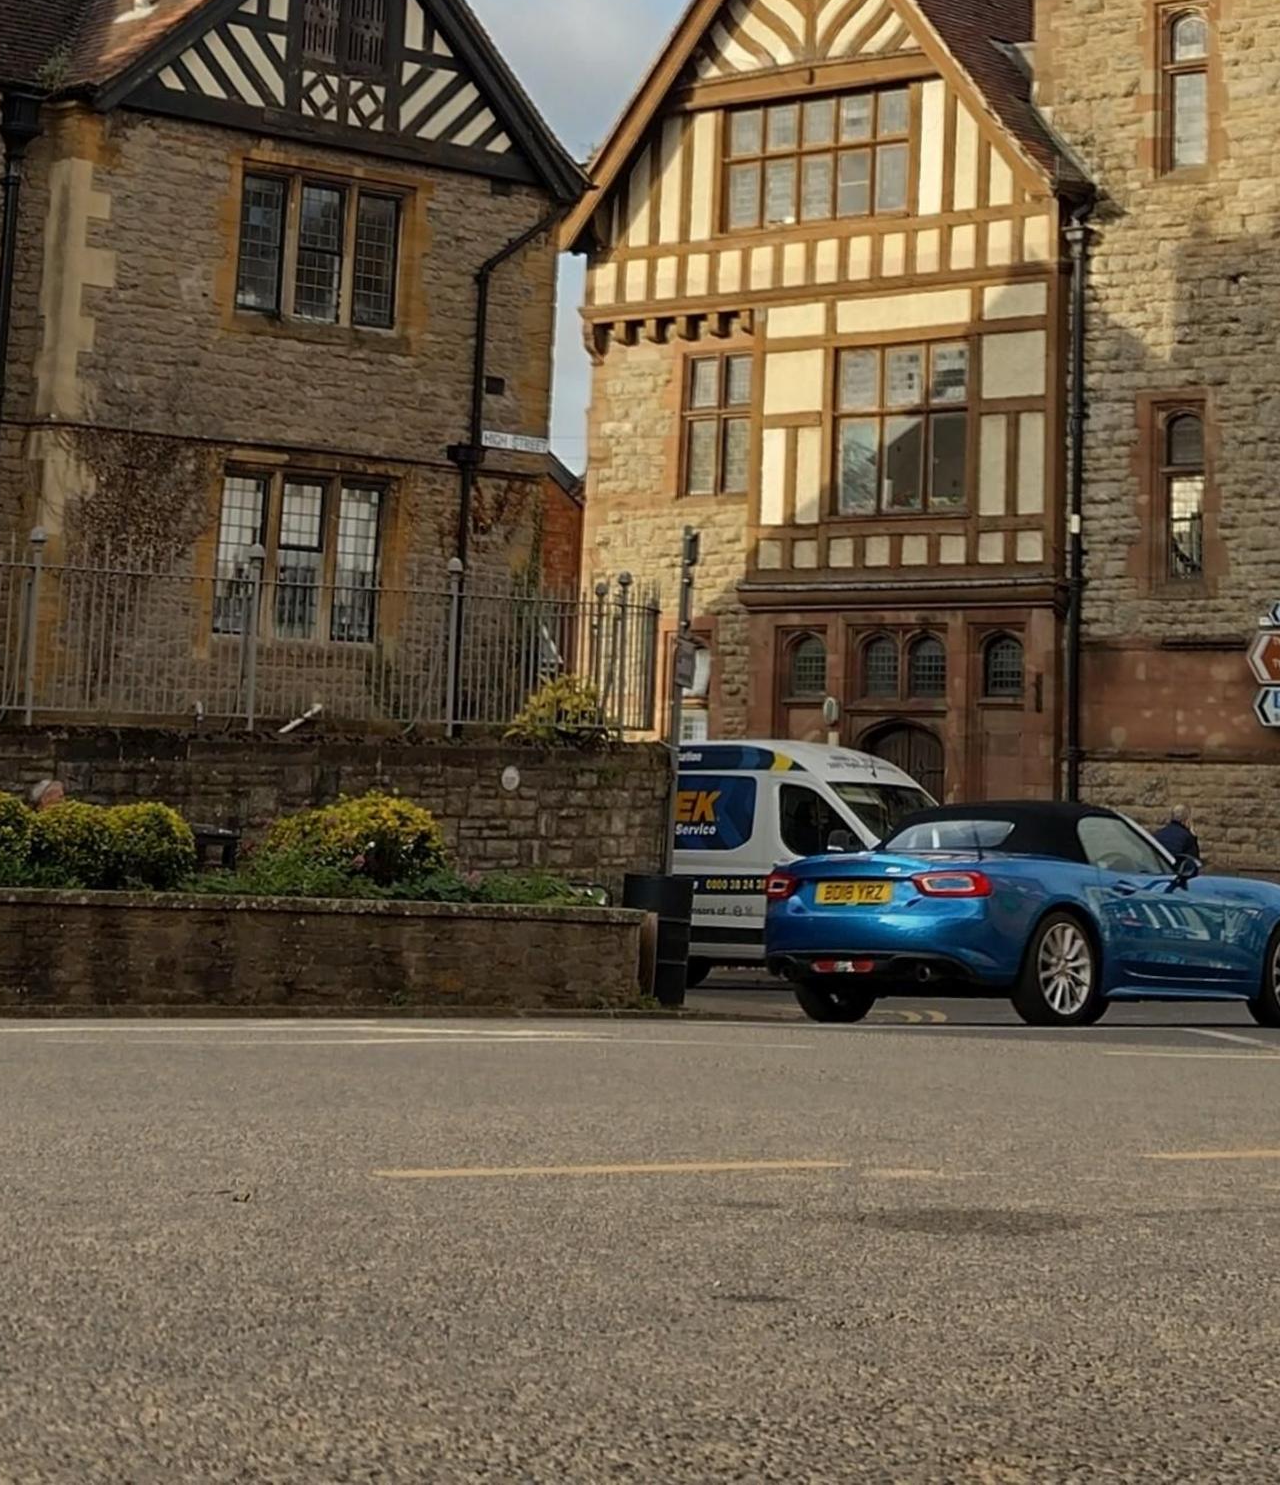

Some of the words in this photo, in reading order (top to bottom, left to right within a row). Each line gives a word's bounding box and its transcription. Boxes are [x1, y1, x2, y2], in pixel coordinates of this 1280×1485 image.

[484, 432, 508, 446] HIGH
[512, 435, 548, 452] STREET
[676, 790, 723, 822] EK
[675, 823, 717, 836] Service
[856, 884, 885, 901] YRZ
